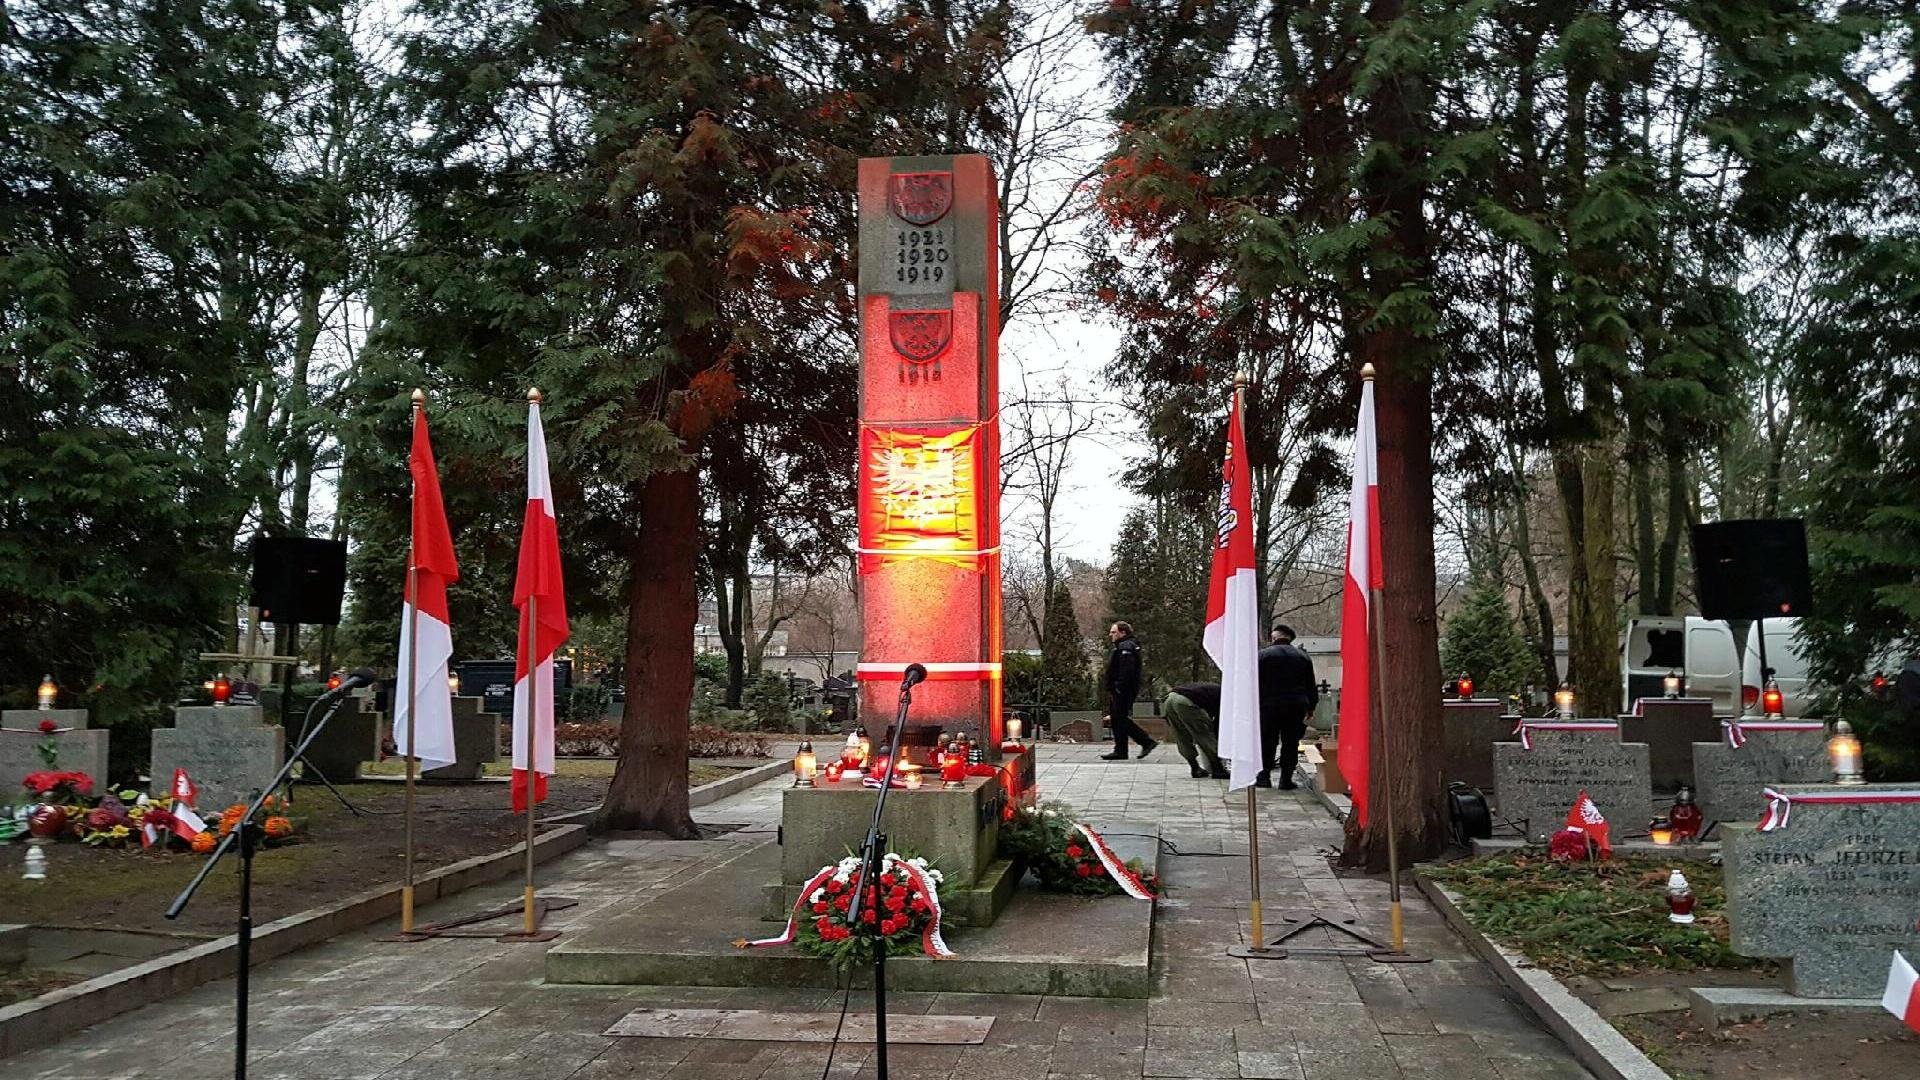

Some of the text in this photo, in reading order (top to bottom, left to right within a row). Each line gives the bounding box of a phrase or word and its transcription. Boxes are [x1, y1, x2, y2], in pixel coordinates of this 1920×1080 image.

[898, 230, 943, 246] 1921
[898, 248, 949, 265] 1920
[896, 266, 943, 284] 1919
[1753, 851, 1816, 866] STEFAN
